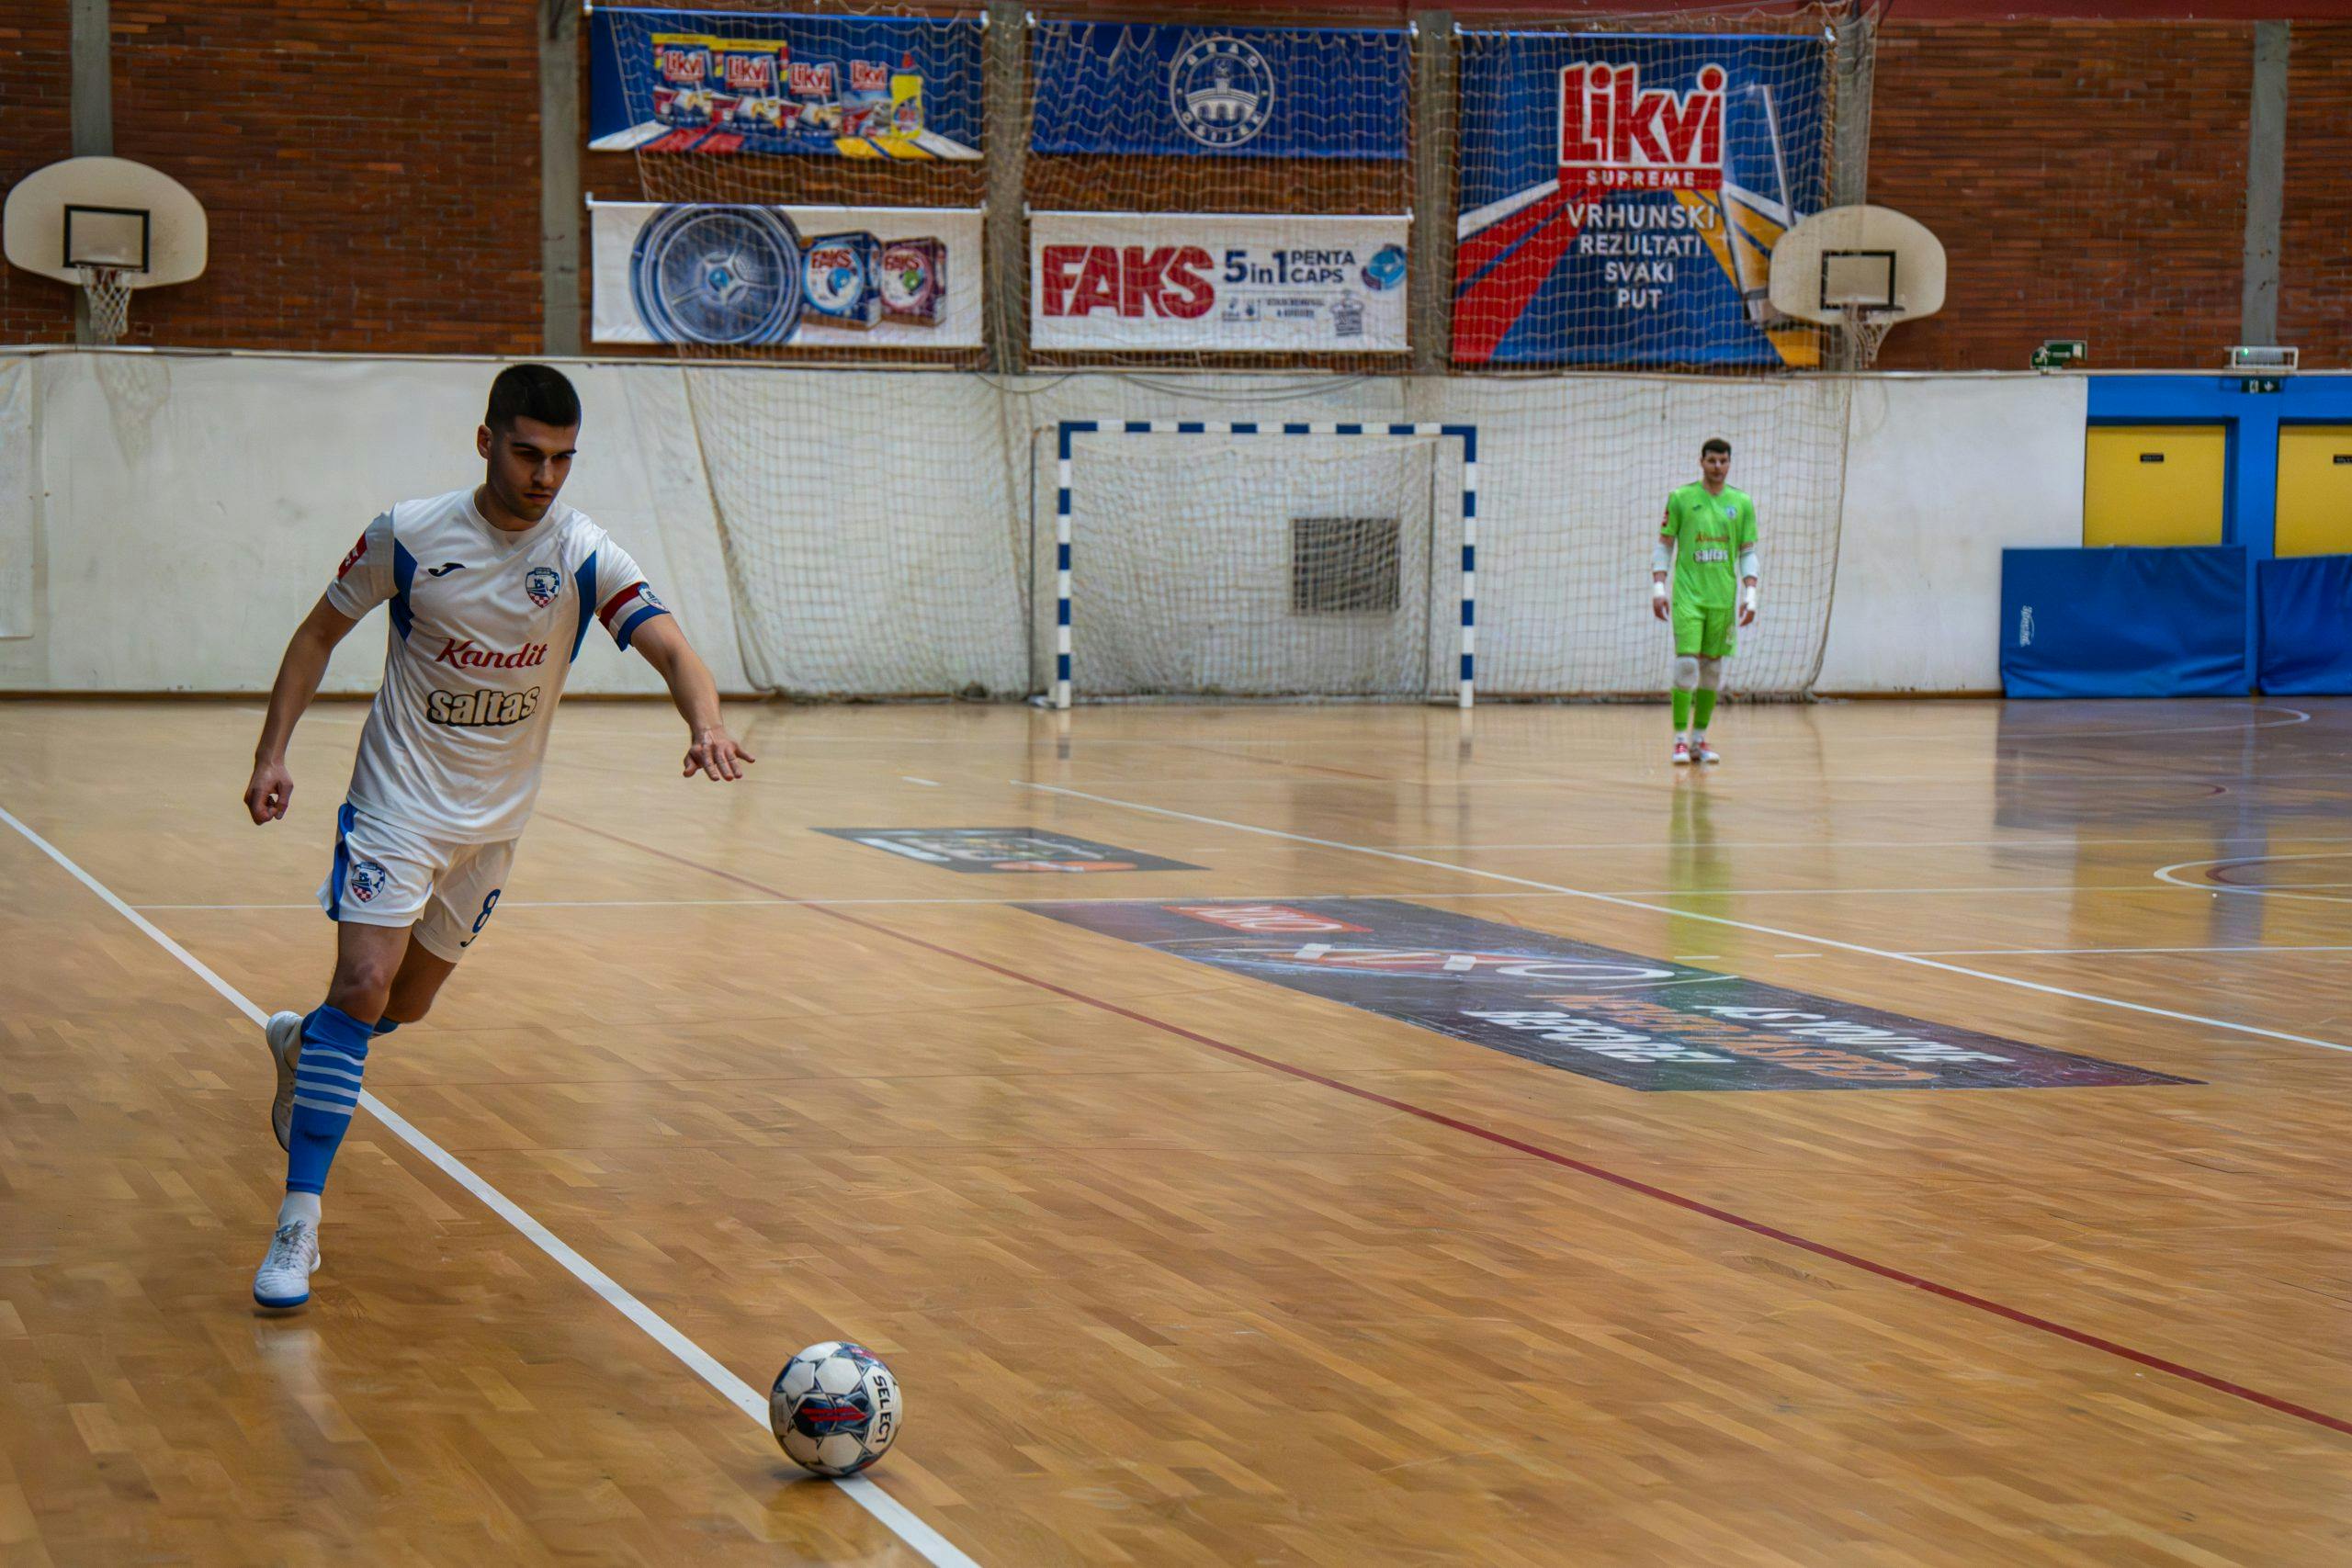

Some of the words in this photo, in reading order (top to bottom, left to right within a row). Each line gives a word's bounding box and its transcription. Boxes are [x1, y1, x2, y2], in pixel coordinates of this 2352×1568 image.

[1560, 63, 1726, 165] Likvi
[1587, 169, 1695, 187] SUPREME
[1566, 202, 1715, 229] VRHUNSKI
[1291, 249, 1356, 265] PENTA
[1579, 233, 1702, 256] REZULTATI
[1042, 244, 1216, 319] FAKS
[1224, 249, 1287, 283] 5in1
[1291, 267, 1344, 284] CAPS
[1604, 262, 1674, 283] SVAKI
[1617, 288, 1663, 310] PUT
[435, 637, 548, 670] Kandit
[426, 686, 540, 727] saltas
[472, 888, 502, 934] 8
[1458, 1010, 1736, 1063] BEFORE!
[873, 1375, 892, 1444] SELECT
